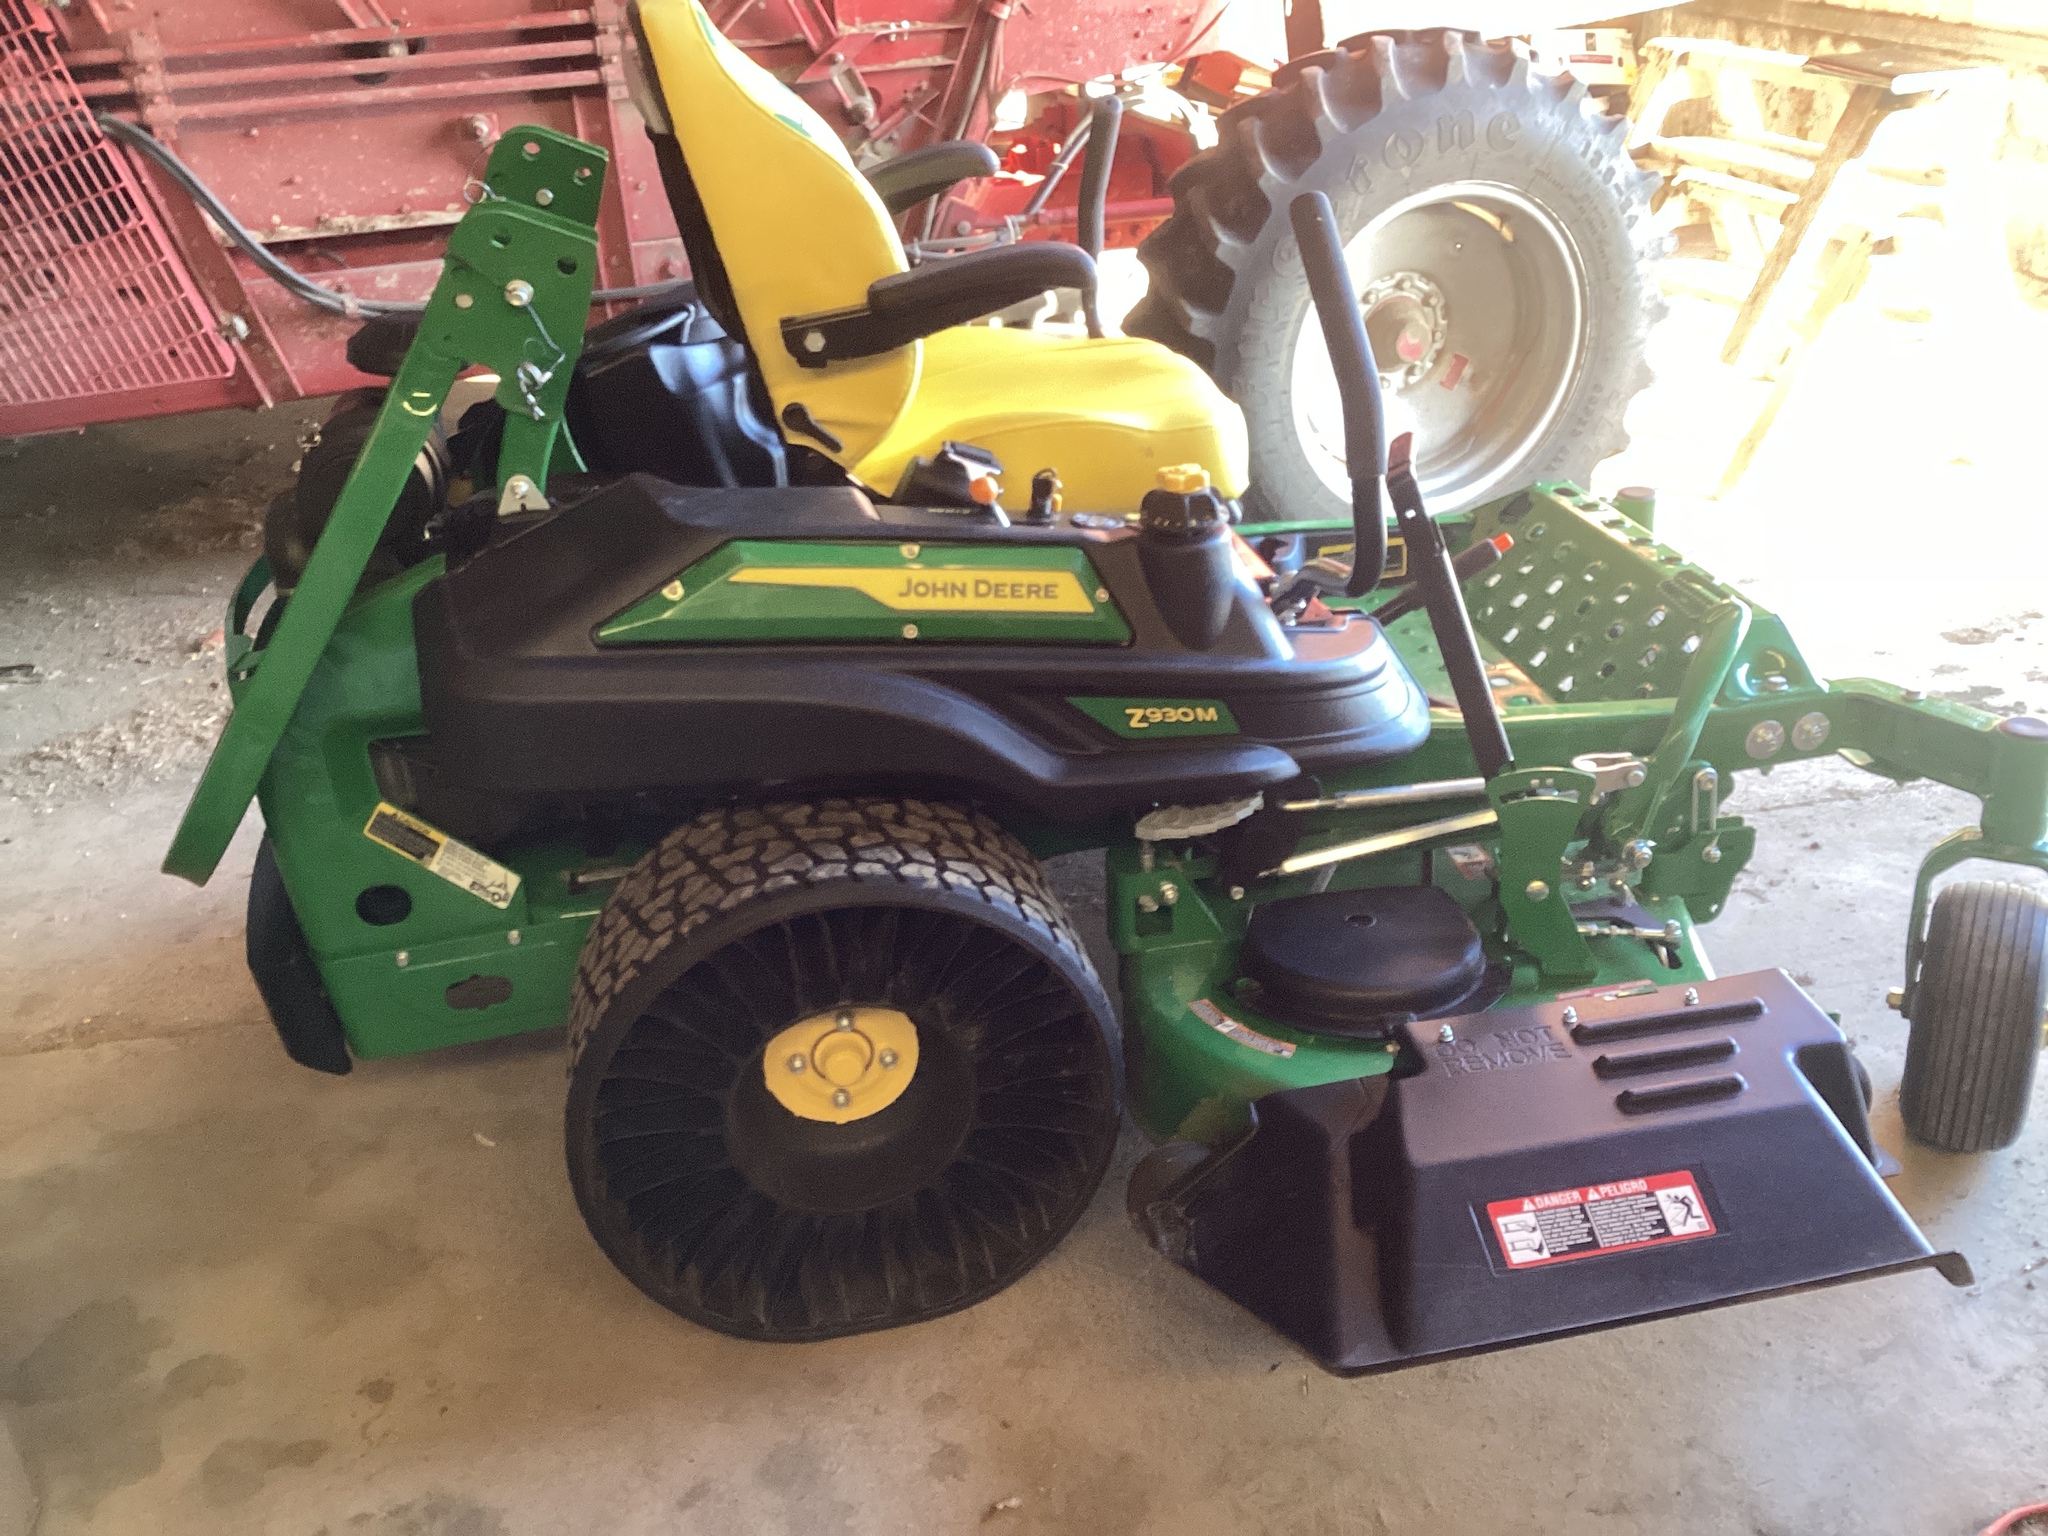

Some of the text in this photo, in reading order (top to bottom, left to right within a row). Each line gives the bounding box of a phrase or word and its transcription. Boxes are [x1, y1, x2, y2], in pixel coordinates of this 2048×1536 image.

[898, 576, 1059, 599] JOHN DEERE
[1125, 706, 1218, 728] Z930M
[1493, 1025, 1552, 1047] NOT
[1441, 1041, 1573, 1078] REMOVE
[1534, 1179, 1649, 1209] DANGER PELIGRO
